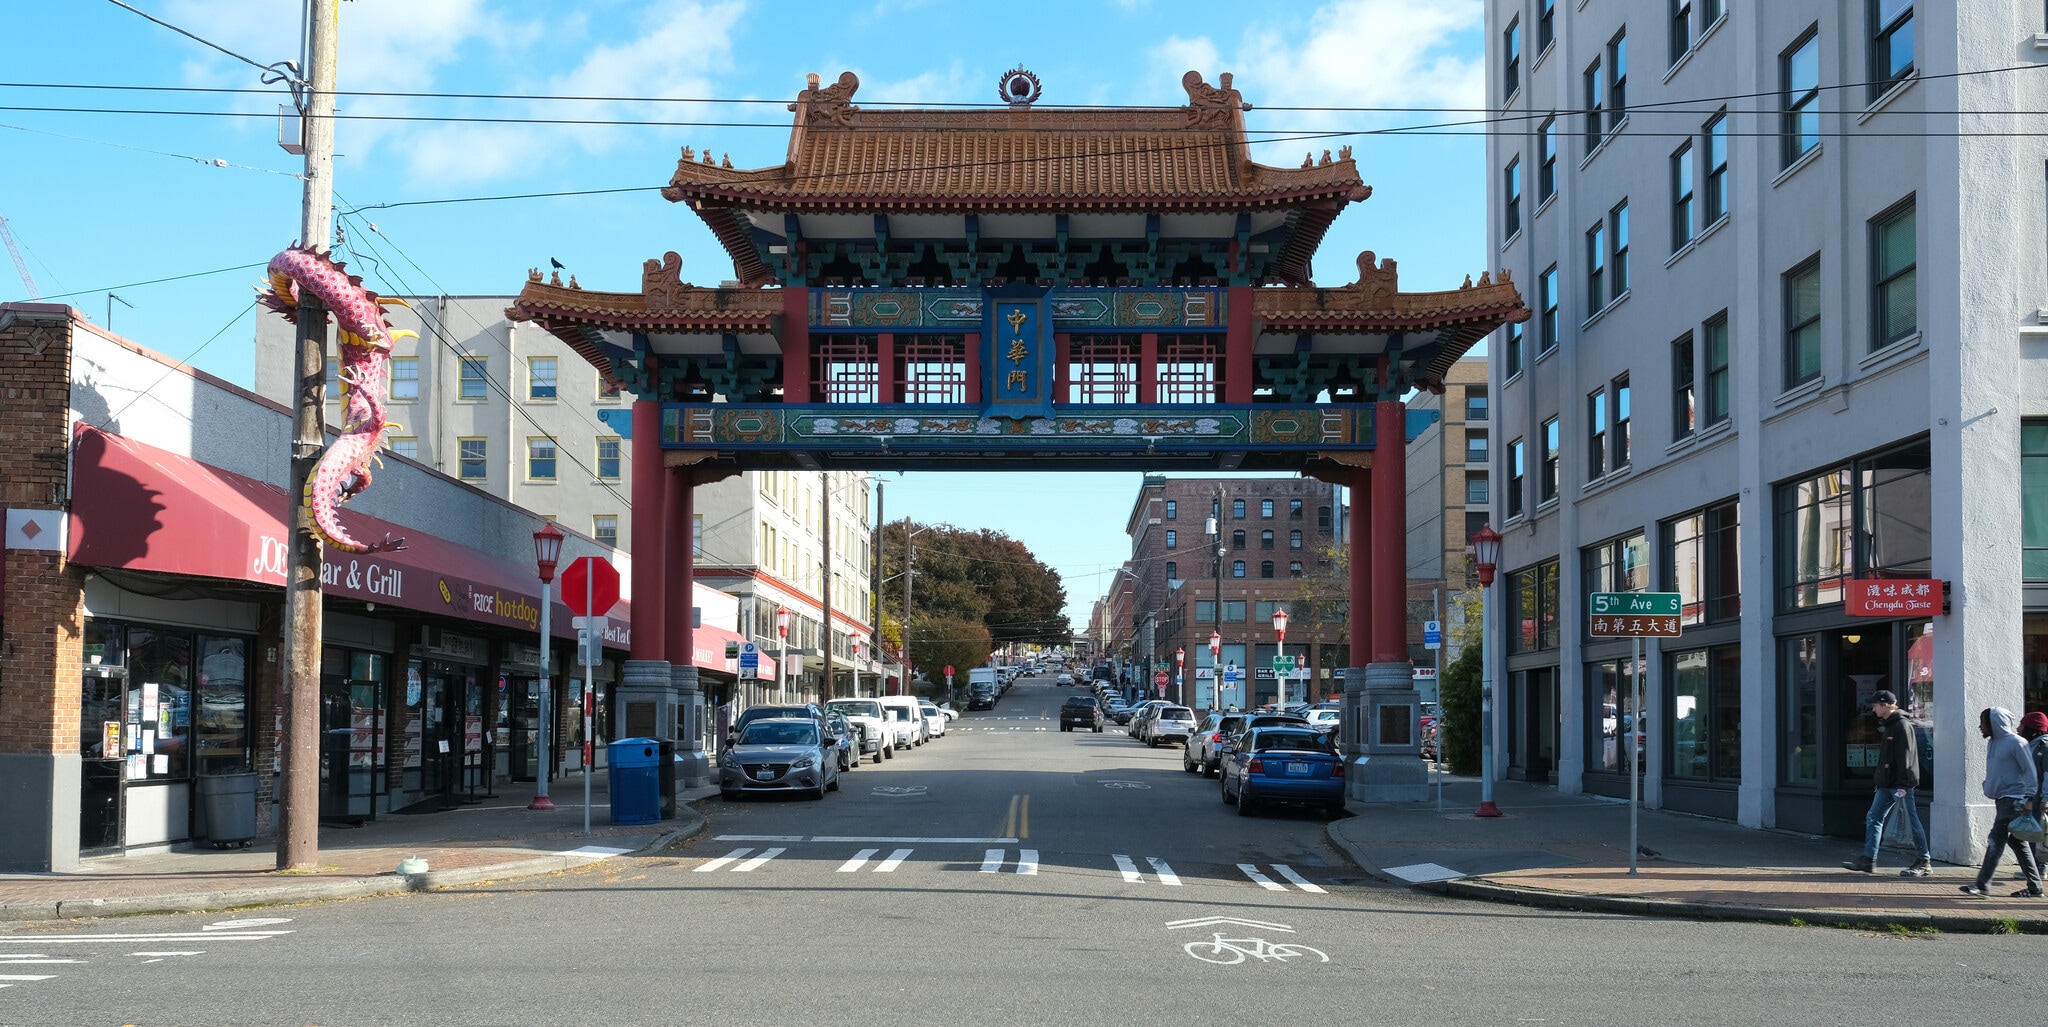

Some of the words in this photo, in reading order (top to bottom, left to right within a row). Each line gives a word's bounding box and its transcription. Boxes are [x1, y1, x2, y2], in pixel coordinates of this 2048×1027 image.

[1006, 309, 1029, 393] 中華門
[1181, 482, 1261, 496] HOEL
[322, 562, 342, 586] ar
[346, 560, 361, 590] &
[366, 564, 402, 598] Grill
[1867, 584, 1930, 597] 滋味成都
[473, 593, 493, 613] RICE
[495, 591, 538, 630] hotdog
[1595, 596, 1620, 612] 5th
[1630, 598, 1652, 610] Ave
[1670, 599, 1678, 610] S
[1865, 600, 1904, 612] Chengdu
[1905, 600, 1931, 611] Taste
[1594, 618, 1678, 633] 南第五大道
[604, 626, 616, 642] Best
[616, 626, 627, 643] Tea
